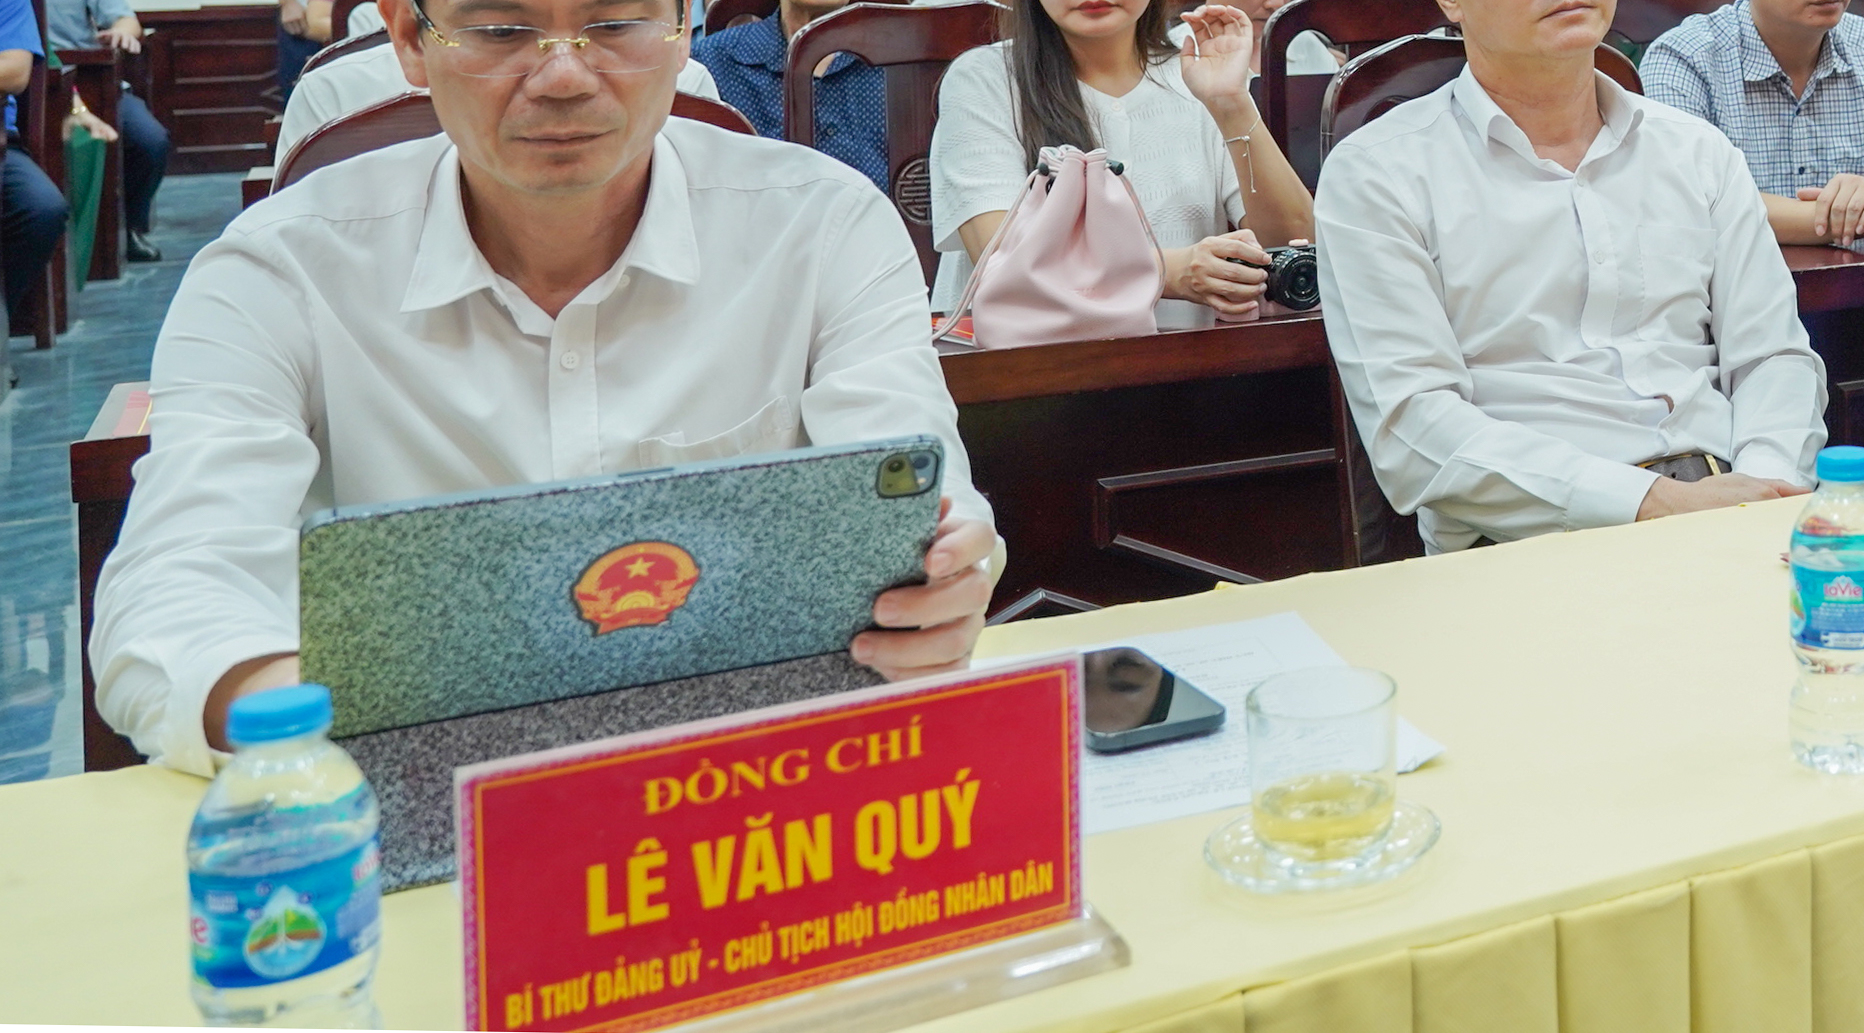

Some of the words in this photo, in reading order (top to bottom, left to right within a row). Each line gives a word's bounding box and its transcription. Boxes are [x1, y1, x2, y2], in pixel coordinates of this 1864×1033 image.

[642, 748, 810, 815] ĐỒNG
[825, 715, 923, 773] CHÍ
[586, 837, 670, 936] LÊ
[692, 812, 833, 910] VĂN
[854, 767, 981, 875] QUÝ
[506, 982, 533, 1029] BÍ
[538, 972, 591, 1019] THƯ
[594, 955, 664, 1006] ĐẢNG
[724, 920, 773, 973] CHỦ
[777, 916, 830, 964] TỊCH
[835, 901, 873, 948] HỘI
[878, 887, 940, 934] ĐỒNG
[944, 871, 1005, 918] NHÂN
[1009, 859, 1053, 901] DÂN
